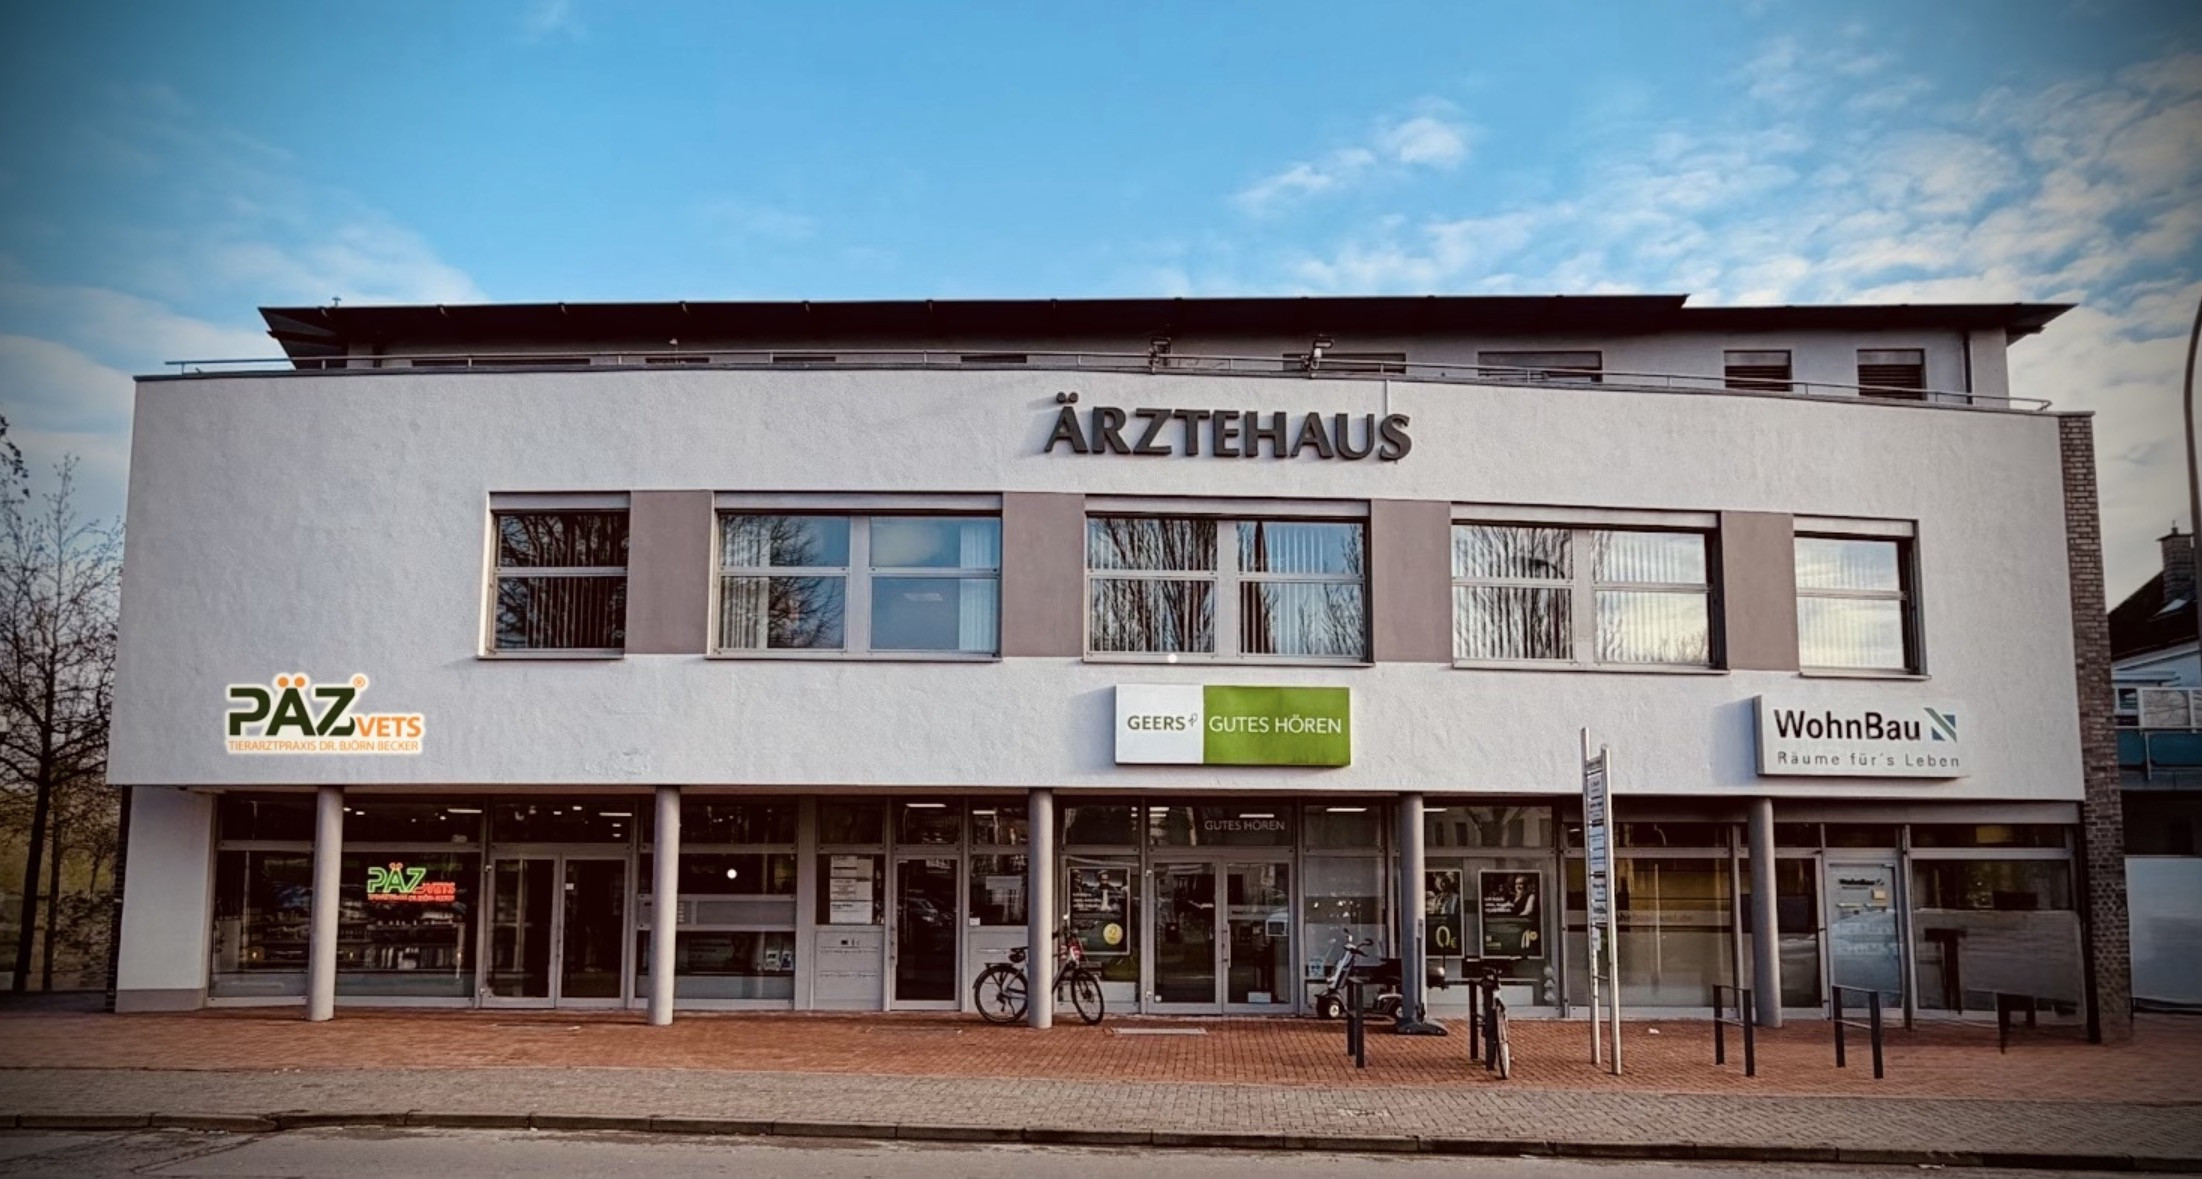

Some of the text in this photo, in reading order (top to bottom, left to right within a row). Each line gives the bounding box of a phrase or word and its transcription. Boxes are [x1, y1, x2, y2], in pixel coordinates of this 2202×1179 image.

[1044, 391, 1413, 461] ÄRZTEHAUS
[356, 716, 422, 737] VETS
[1127, 714, 1186, 731] GEERS
[1208, 713, 1342, 735] GUTES HÖREN
[1773, 708, 1921, 741] WohnBau
[228, 739, 419, 751] TIERARZTPRAXIS DR. BJÖRN BECKER
[1777, 750, 1841, 766] Räume
[1904, 753, 1961, 768] Leben
[1204, 820, 1242, 831] GUTES
